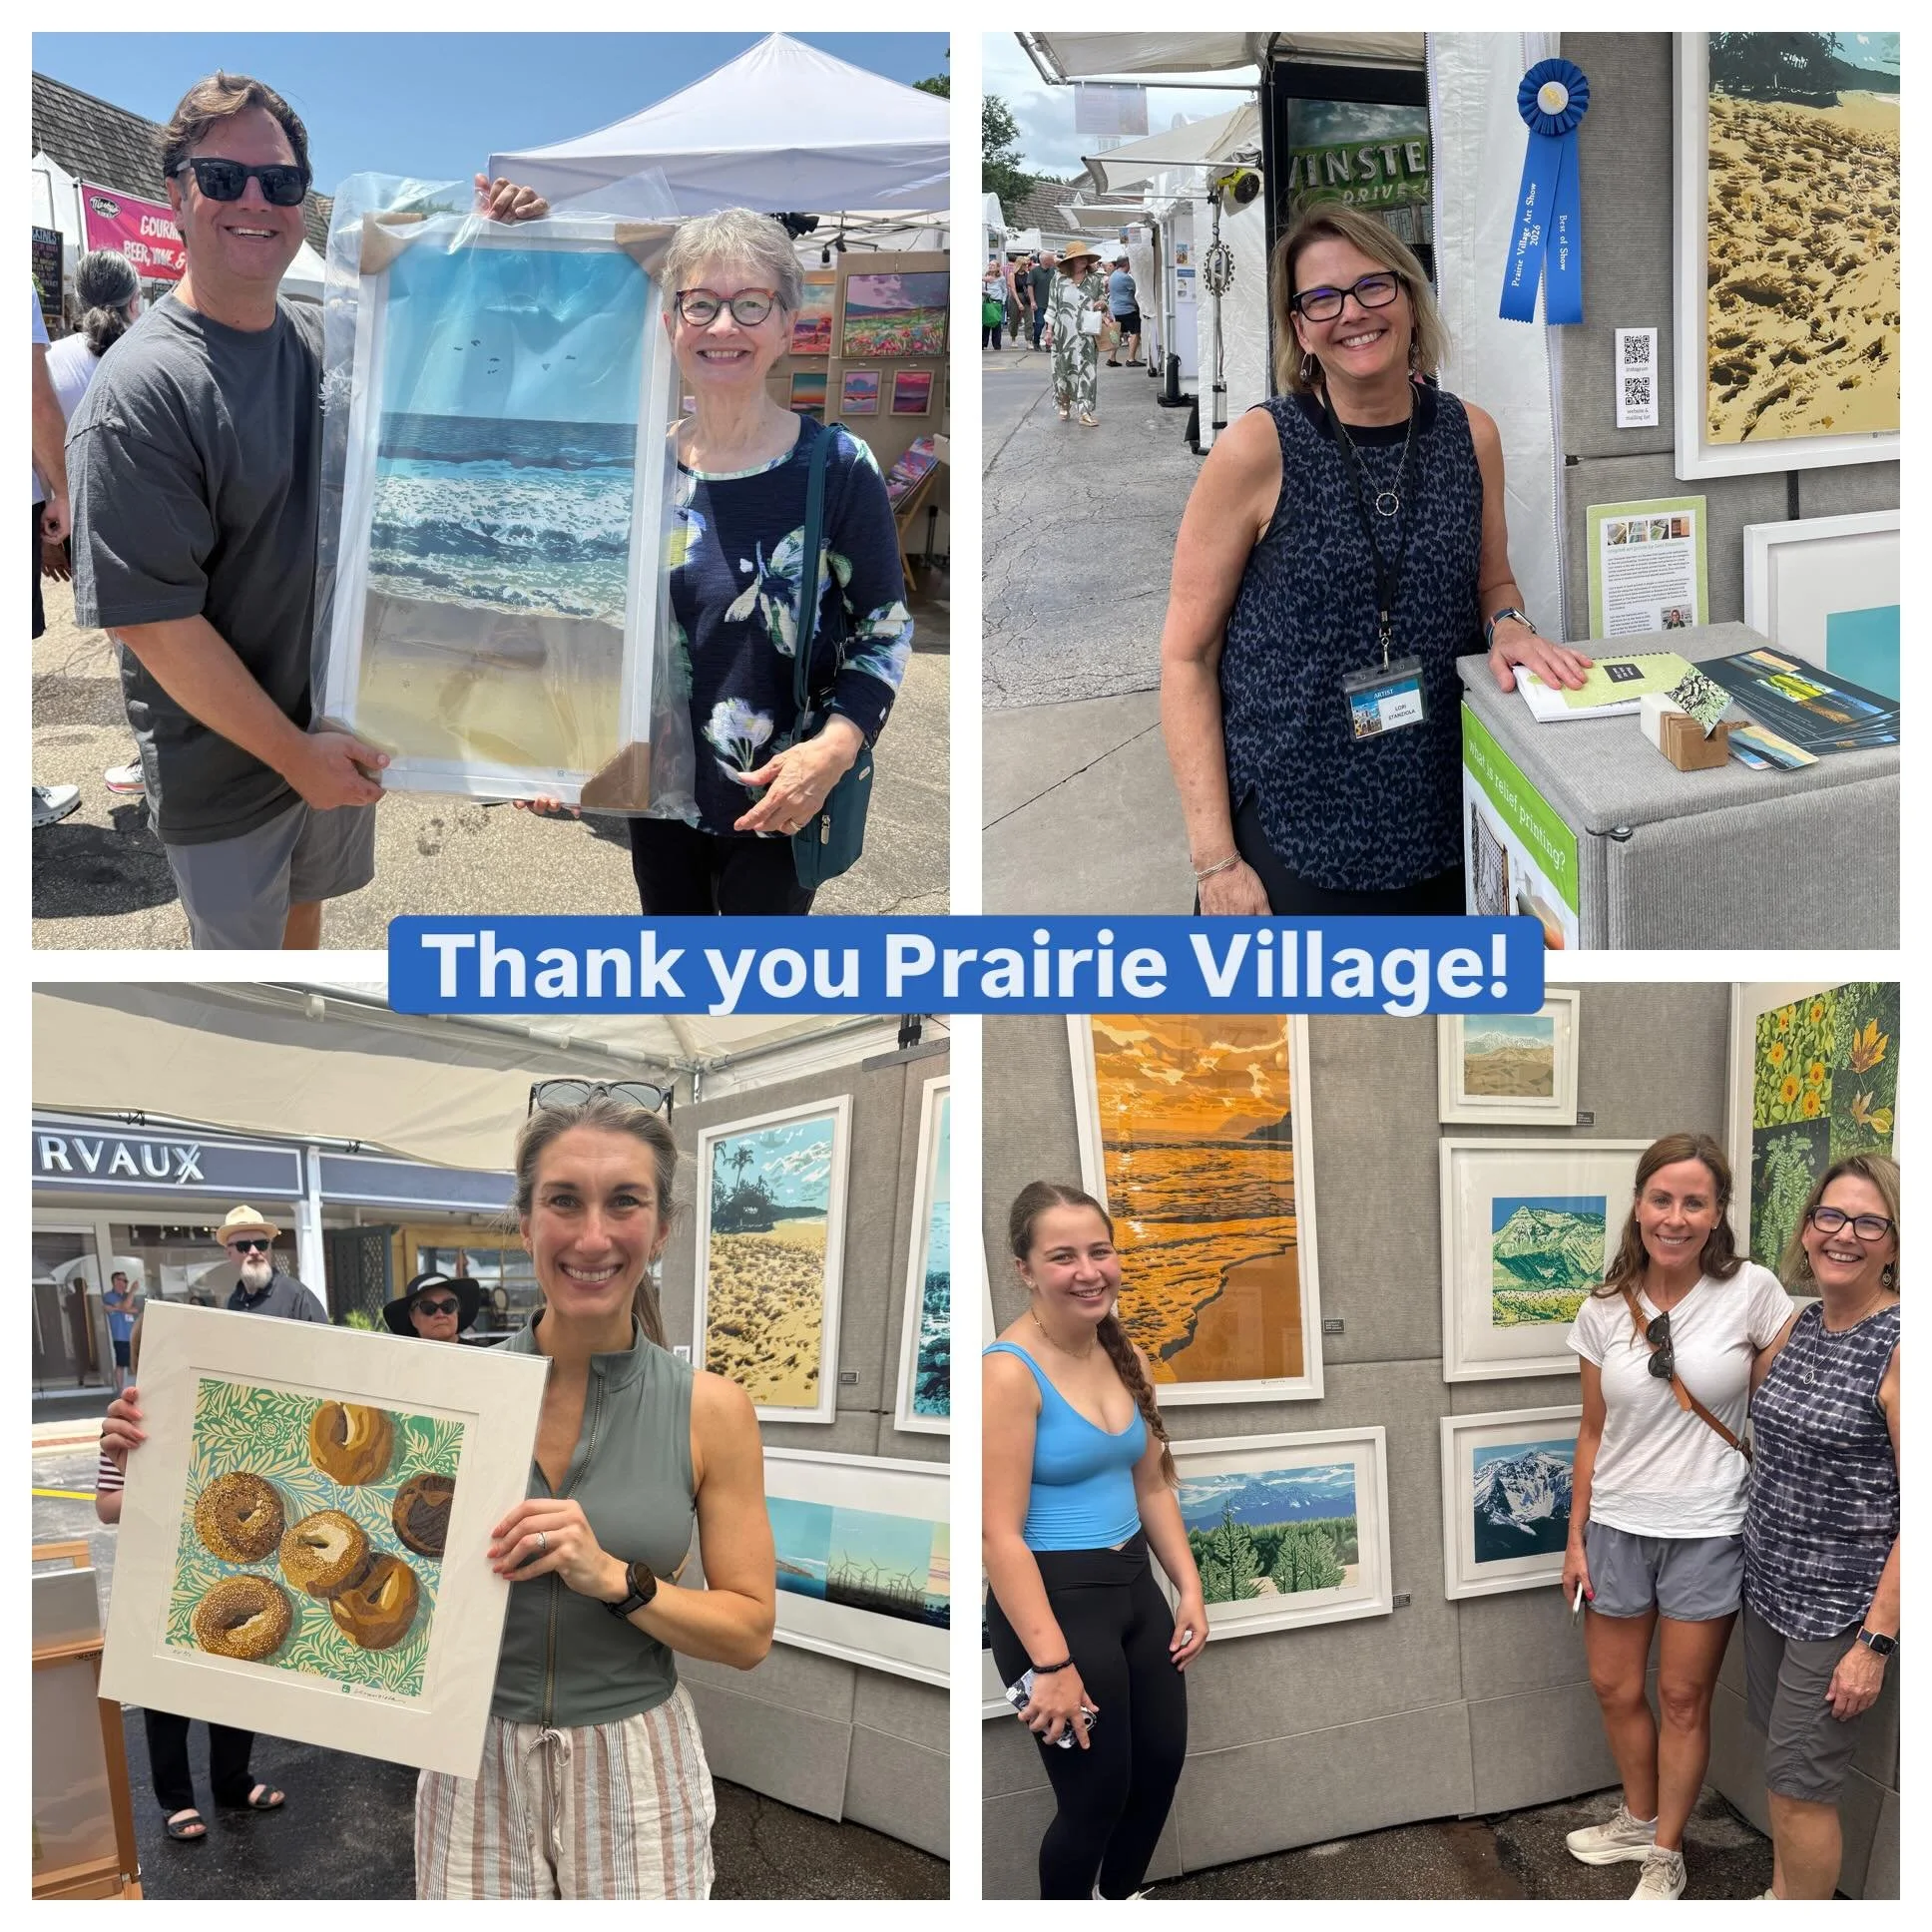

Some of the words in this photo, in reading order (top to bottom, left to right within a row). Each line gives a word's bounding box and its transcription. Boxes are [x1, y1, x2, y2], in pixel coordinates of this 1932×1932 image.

[1526, 183, 1538, 207] Show
[1523, 209, 1533, 224] Art
[1559, 215, 1568, 233] Best
[1516, 227, 1530, 255] Village
[1530, 224, 1541, 246] 2026
[1560, 234, 1568, 244] of
[124, 240, 151, 266] BEER,
[1560, 246, 1569, 271] Show
[1511, 258, 1524, 287] Prairie
[1373, 689, 1393, 699] ARTIST
[1388, 710, 1416, 721] STANZIOLA
[1468, 738, 1486, 768] what
[1486, 759, 1494, 780] is
[1494, 773, 1518, 813] relief
[1519, 806, 1567, 872] printing?
[38, 1136, 205, 1185] RVAUX
